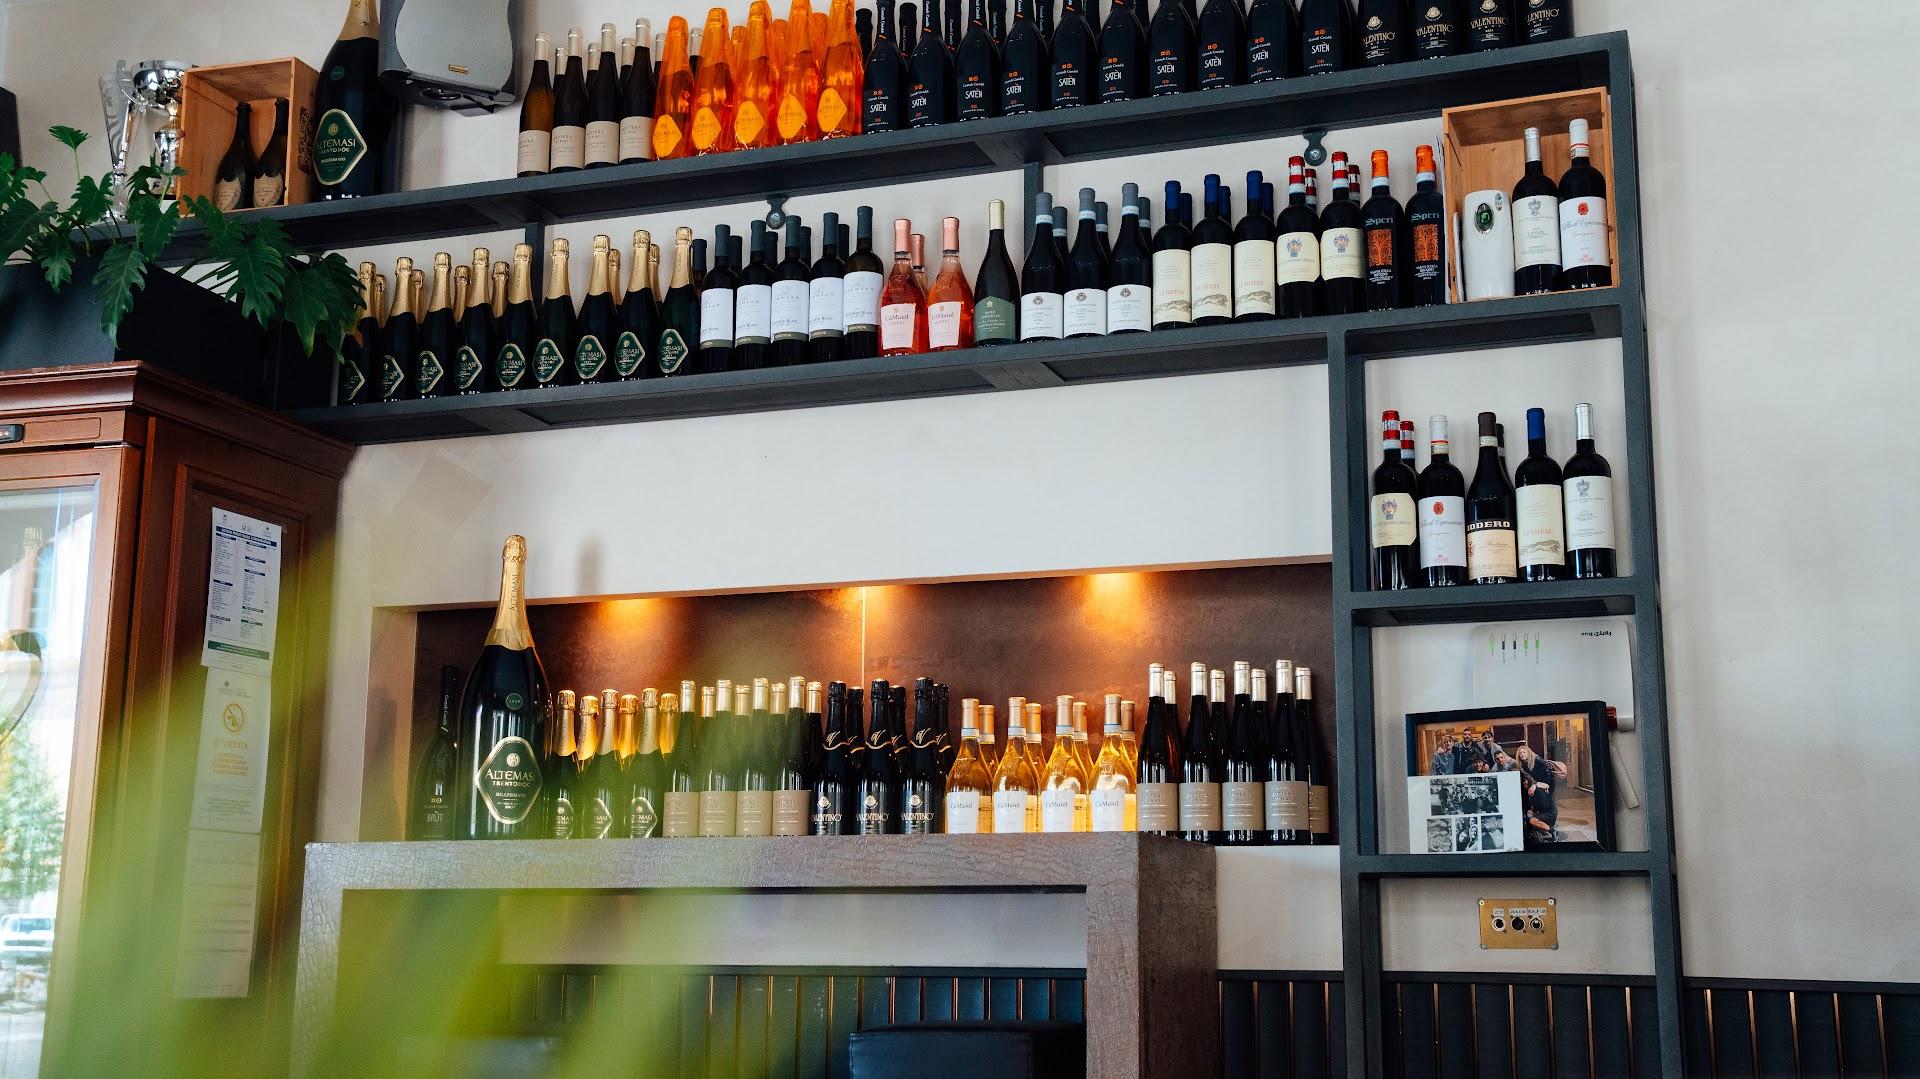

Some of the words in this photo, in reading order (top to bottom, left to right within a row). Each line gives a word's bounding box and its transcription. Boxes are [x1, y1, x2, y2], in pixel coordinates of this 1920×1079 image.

[1527, 9, 1559, 22] LENTINO
[1471, 16, 1508, 29] VALENTINO
[1416, 24, 1453, 37] VALENTINO
[1363, 32, 1395, 44] ALENTINO
[1365, 217, 1394, 227] Speri
[1411, 212, 1440, 222] Speri
